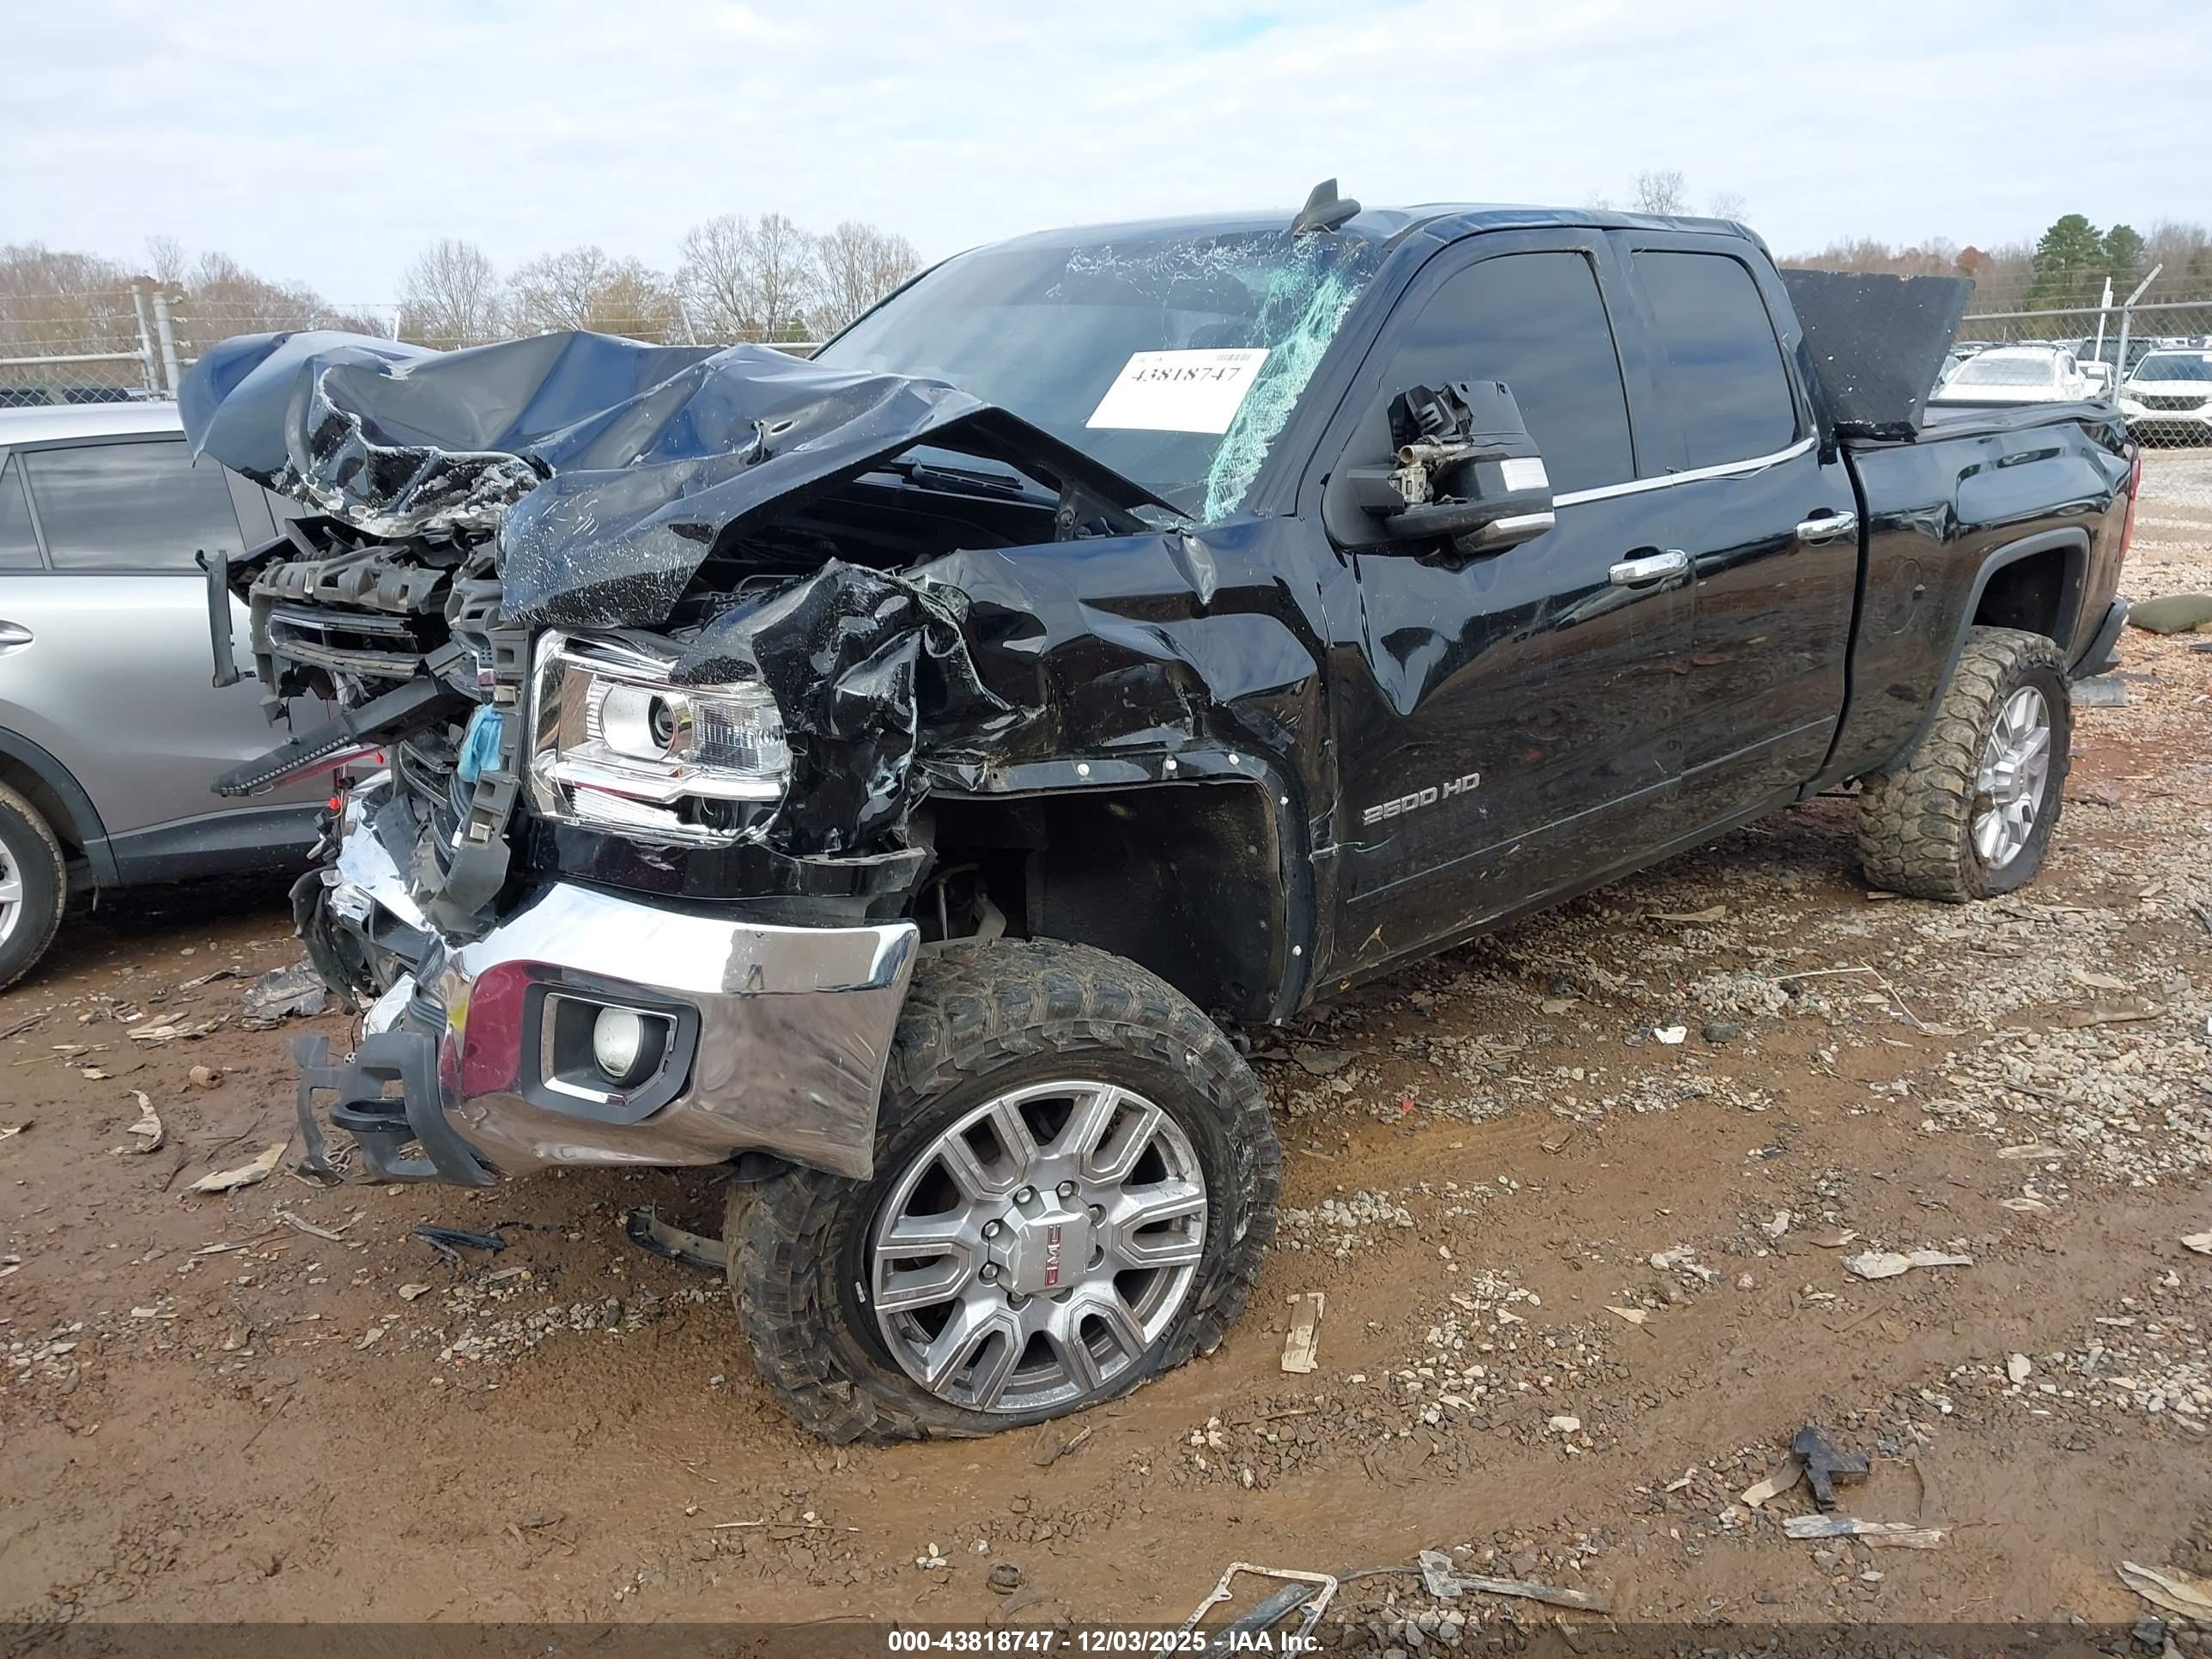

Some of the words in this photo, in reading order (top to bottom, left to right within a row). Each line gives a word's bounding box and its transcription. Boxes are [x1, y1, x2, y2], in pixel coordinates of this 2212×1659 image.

[1132, 367, 1242, 382] 43818747
[1362, 787, 1437, 826] 2500
[1443, 772, 1480, 799] HD
[1044, 1223, 1061, 1287] GMC
